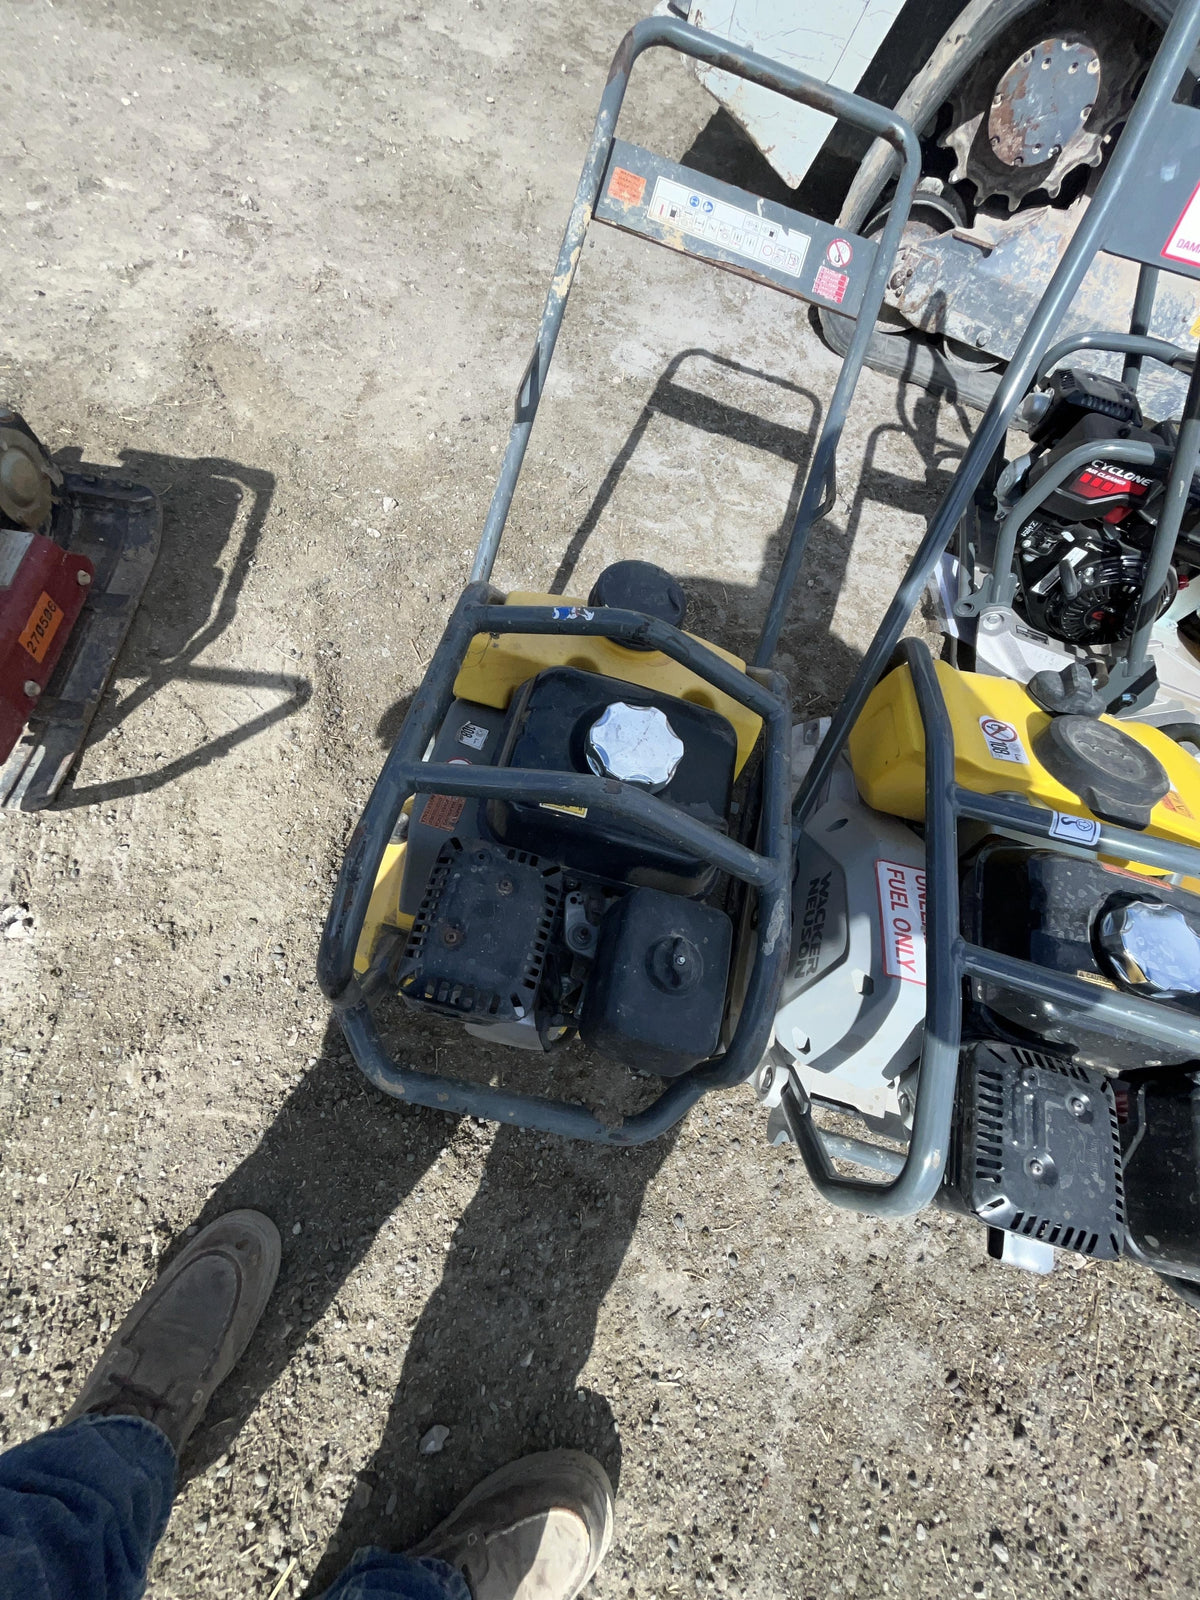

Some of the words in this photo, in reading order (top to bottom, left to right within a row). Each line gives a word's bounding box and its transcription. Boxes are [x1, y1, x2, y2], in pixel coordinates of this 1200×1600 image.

[1085, 467, 1099, 475] AIR
[1091, 459, 1154, 487] CYCLONE
[989, 740, 1011, 756] 108
[886, 867, 909, 911] FUEL
[794, 877, 819, 979] NEUSON
[805, 870, 833, 977] WACKER
[892, 917, 917, 974] ONLY
